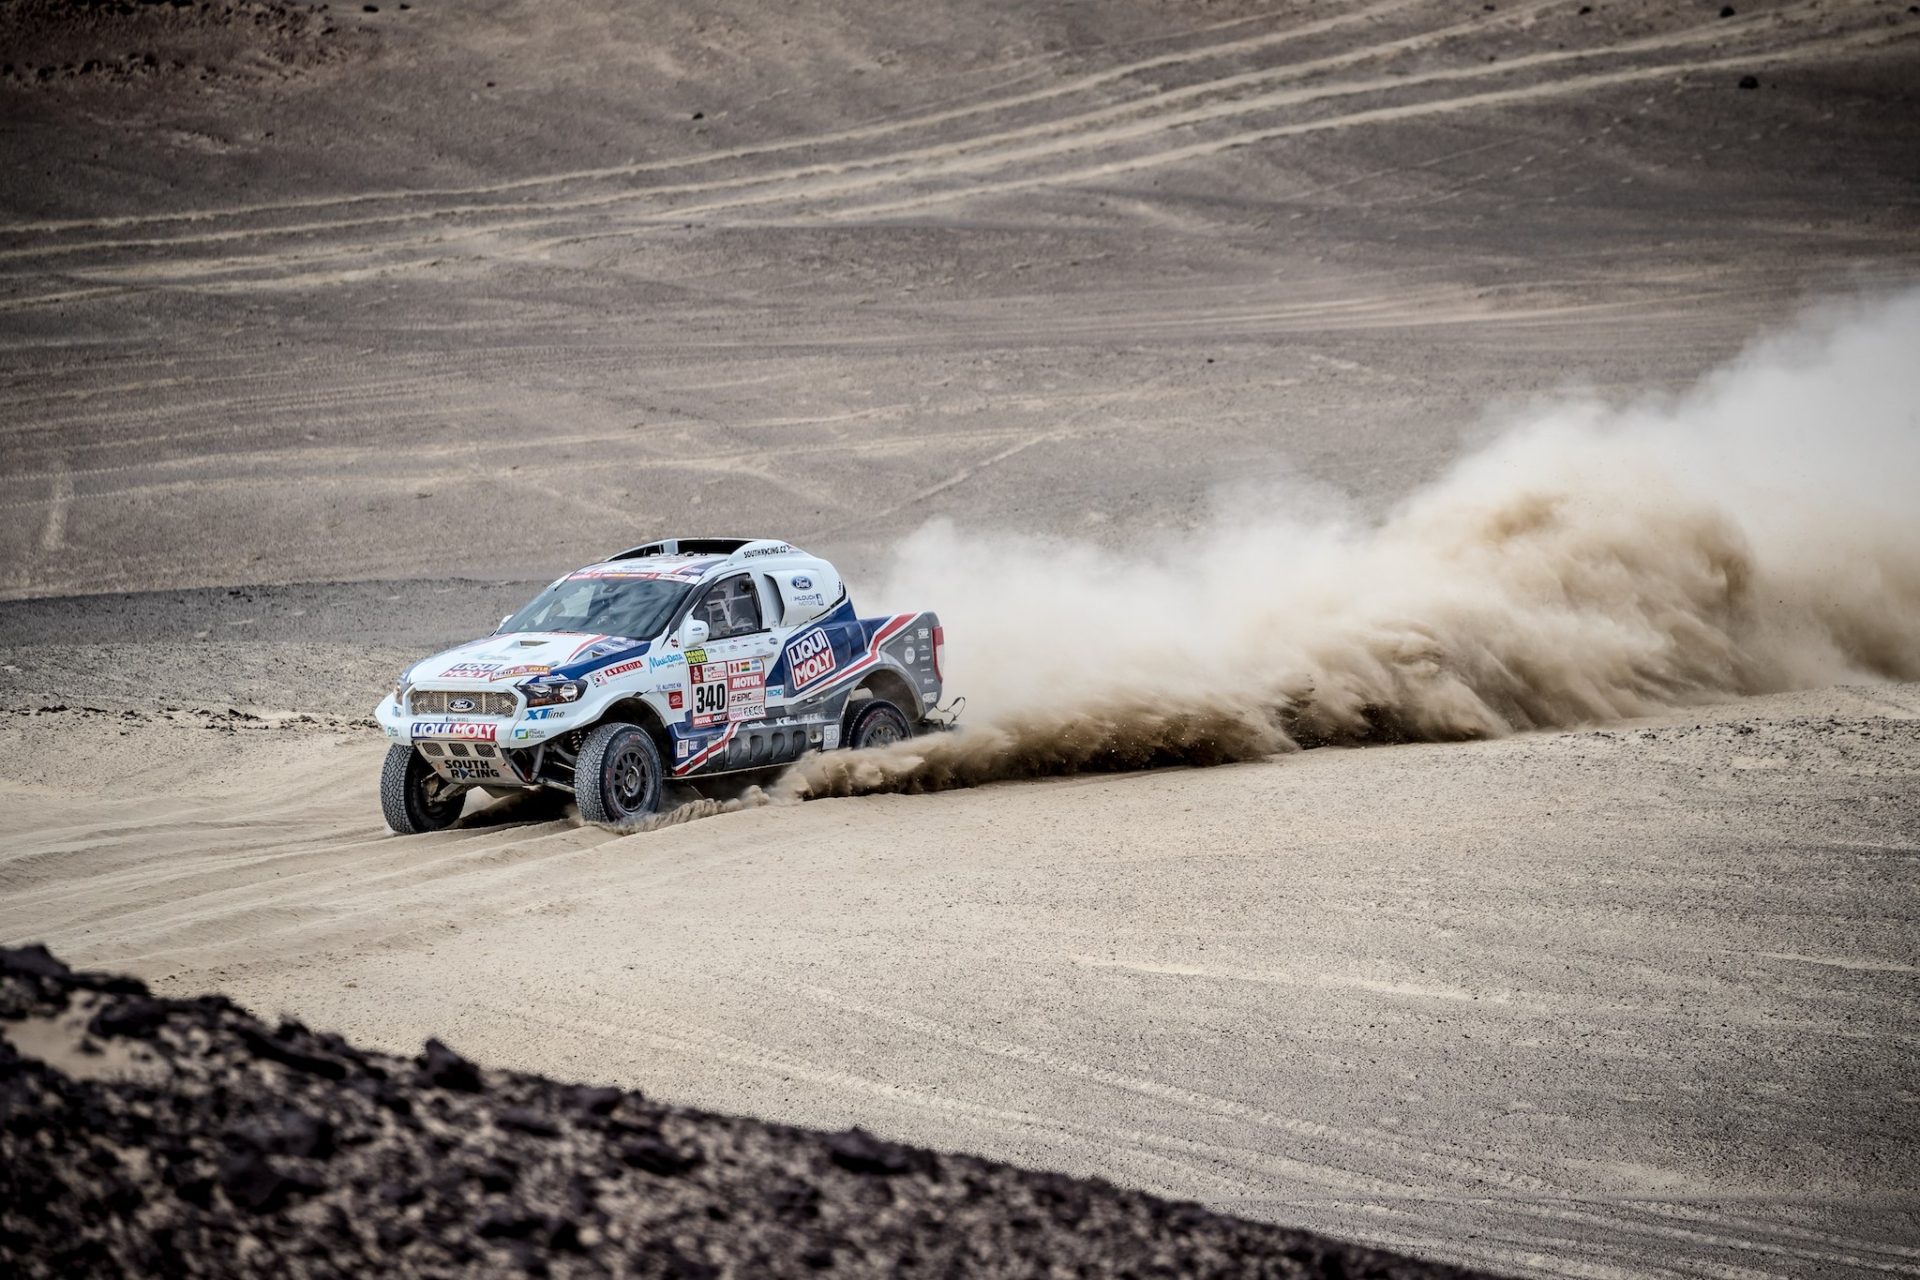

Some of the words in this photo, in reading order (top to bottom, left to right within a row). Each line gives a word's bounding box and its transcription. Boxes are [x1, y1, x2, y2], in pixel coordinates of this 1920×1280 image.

[686, 650, 705, 658] MANN
[790, 632, 827, 665] LIQUI
[688, 655, 707, 664] FILTER
[451, 663, 501, 671] LIQUI
[795, 649, 831, 685] MOLY
[732, 674, 761, 689] MOTUL
[696, 683, 725, 713] 340
[525, 707, 565, 720] XTline
[694, 715, 712, 725] MOTUL
[412, 723, 452, 737] LIQUI
[452, 723, 496, 739] MOLY
[444, 759, 490, 769] SOUTH
